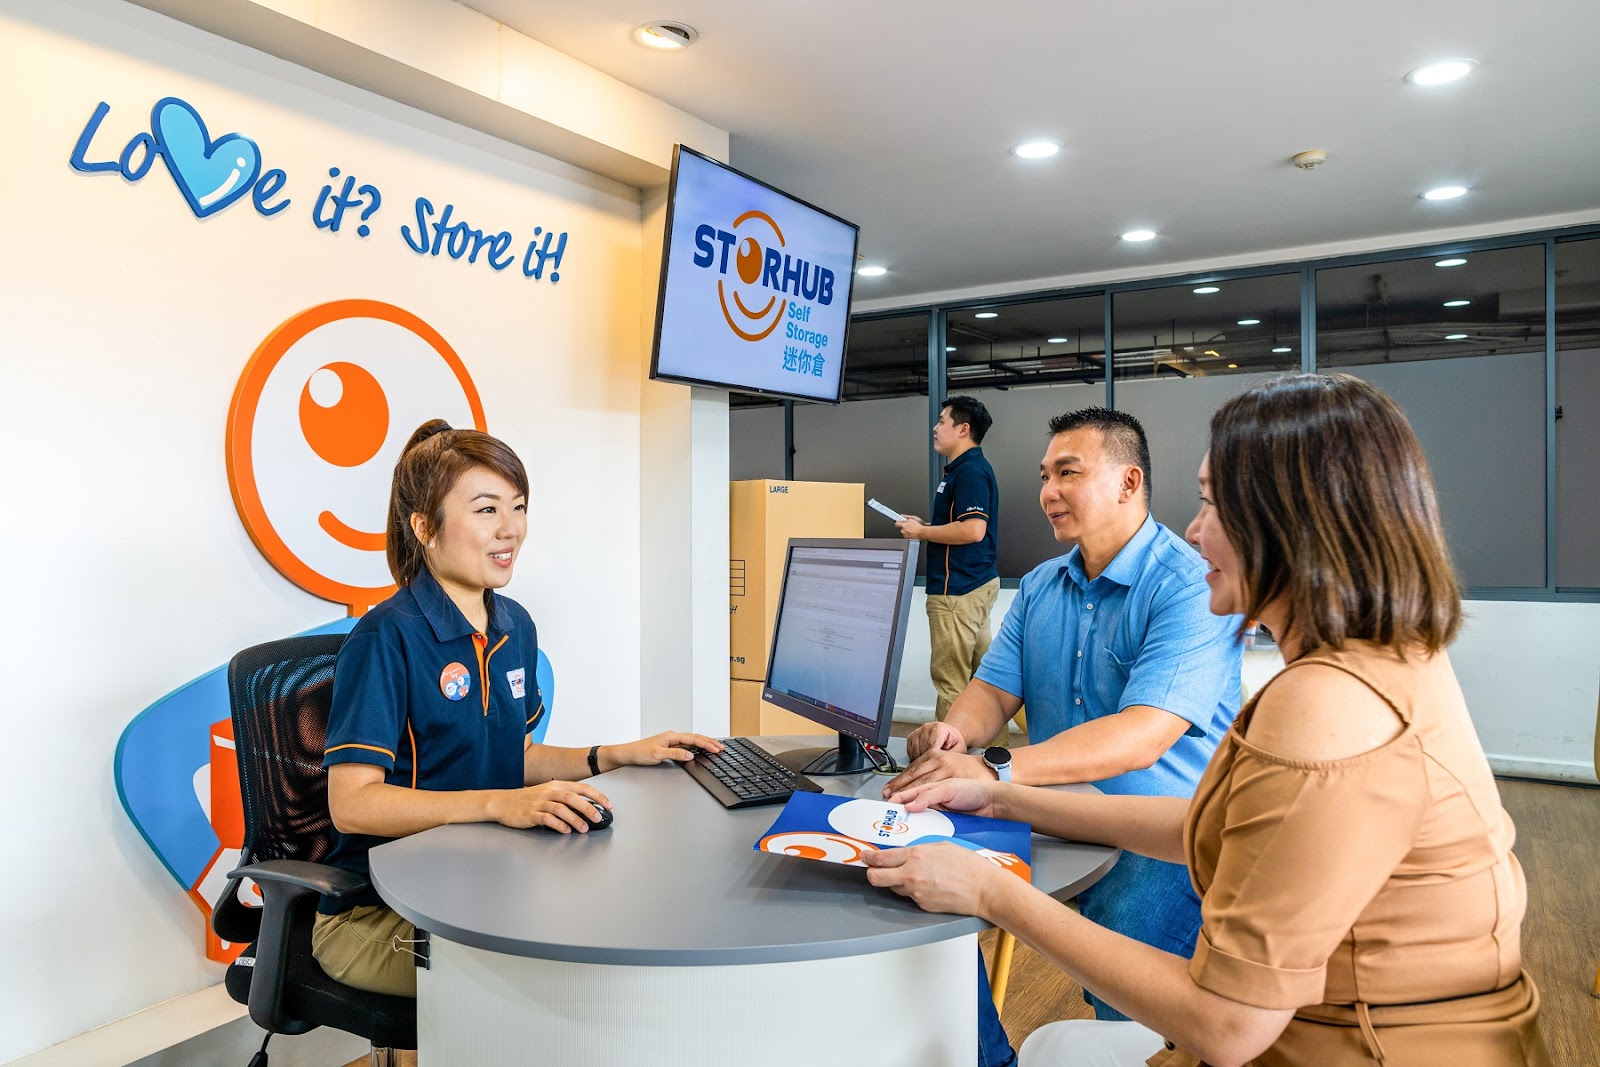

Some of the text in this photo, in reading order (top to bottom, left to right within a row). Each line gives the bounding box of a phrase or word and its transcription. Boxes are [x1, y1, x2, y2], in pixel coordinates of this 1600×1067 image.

[312, 167, 382, 237] it?
[400, 196, 515, 271] Store
[522, 226, 568, 282] it!
[693, 224, 835, 306] STORHUB
[788, 301, 811, 322] Self
[786, 321, 828, 349] Storage
[782, 345, 826, 377] 迷你倉
[769, 485, 789, 494] LARGE
[878, 810, 898, 837] STORHUB
